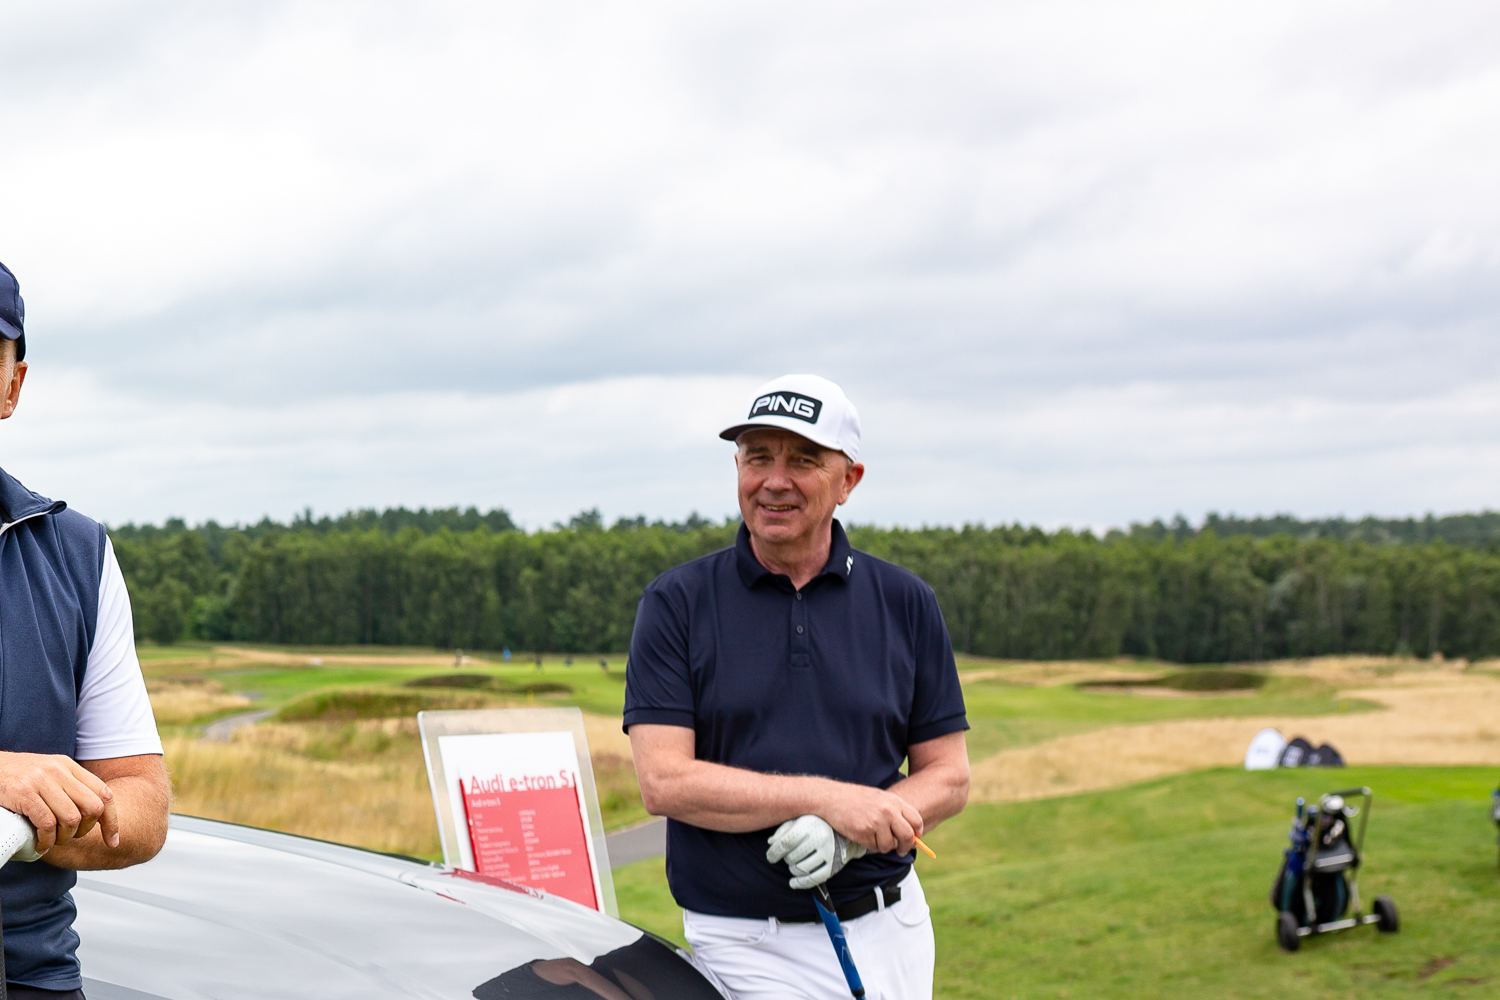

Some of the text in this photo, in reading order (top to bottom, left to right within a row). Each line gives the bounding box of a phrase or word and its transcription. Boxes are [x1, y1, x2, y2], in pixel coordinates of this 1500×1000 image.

[752, 395, 815, 418] PING
[470, 769, 569, 794] Audi e-tron S
